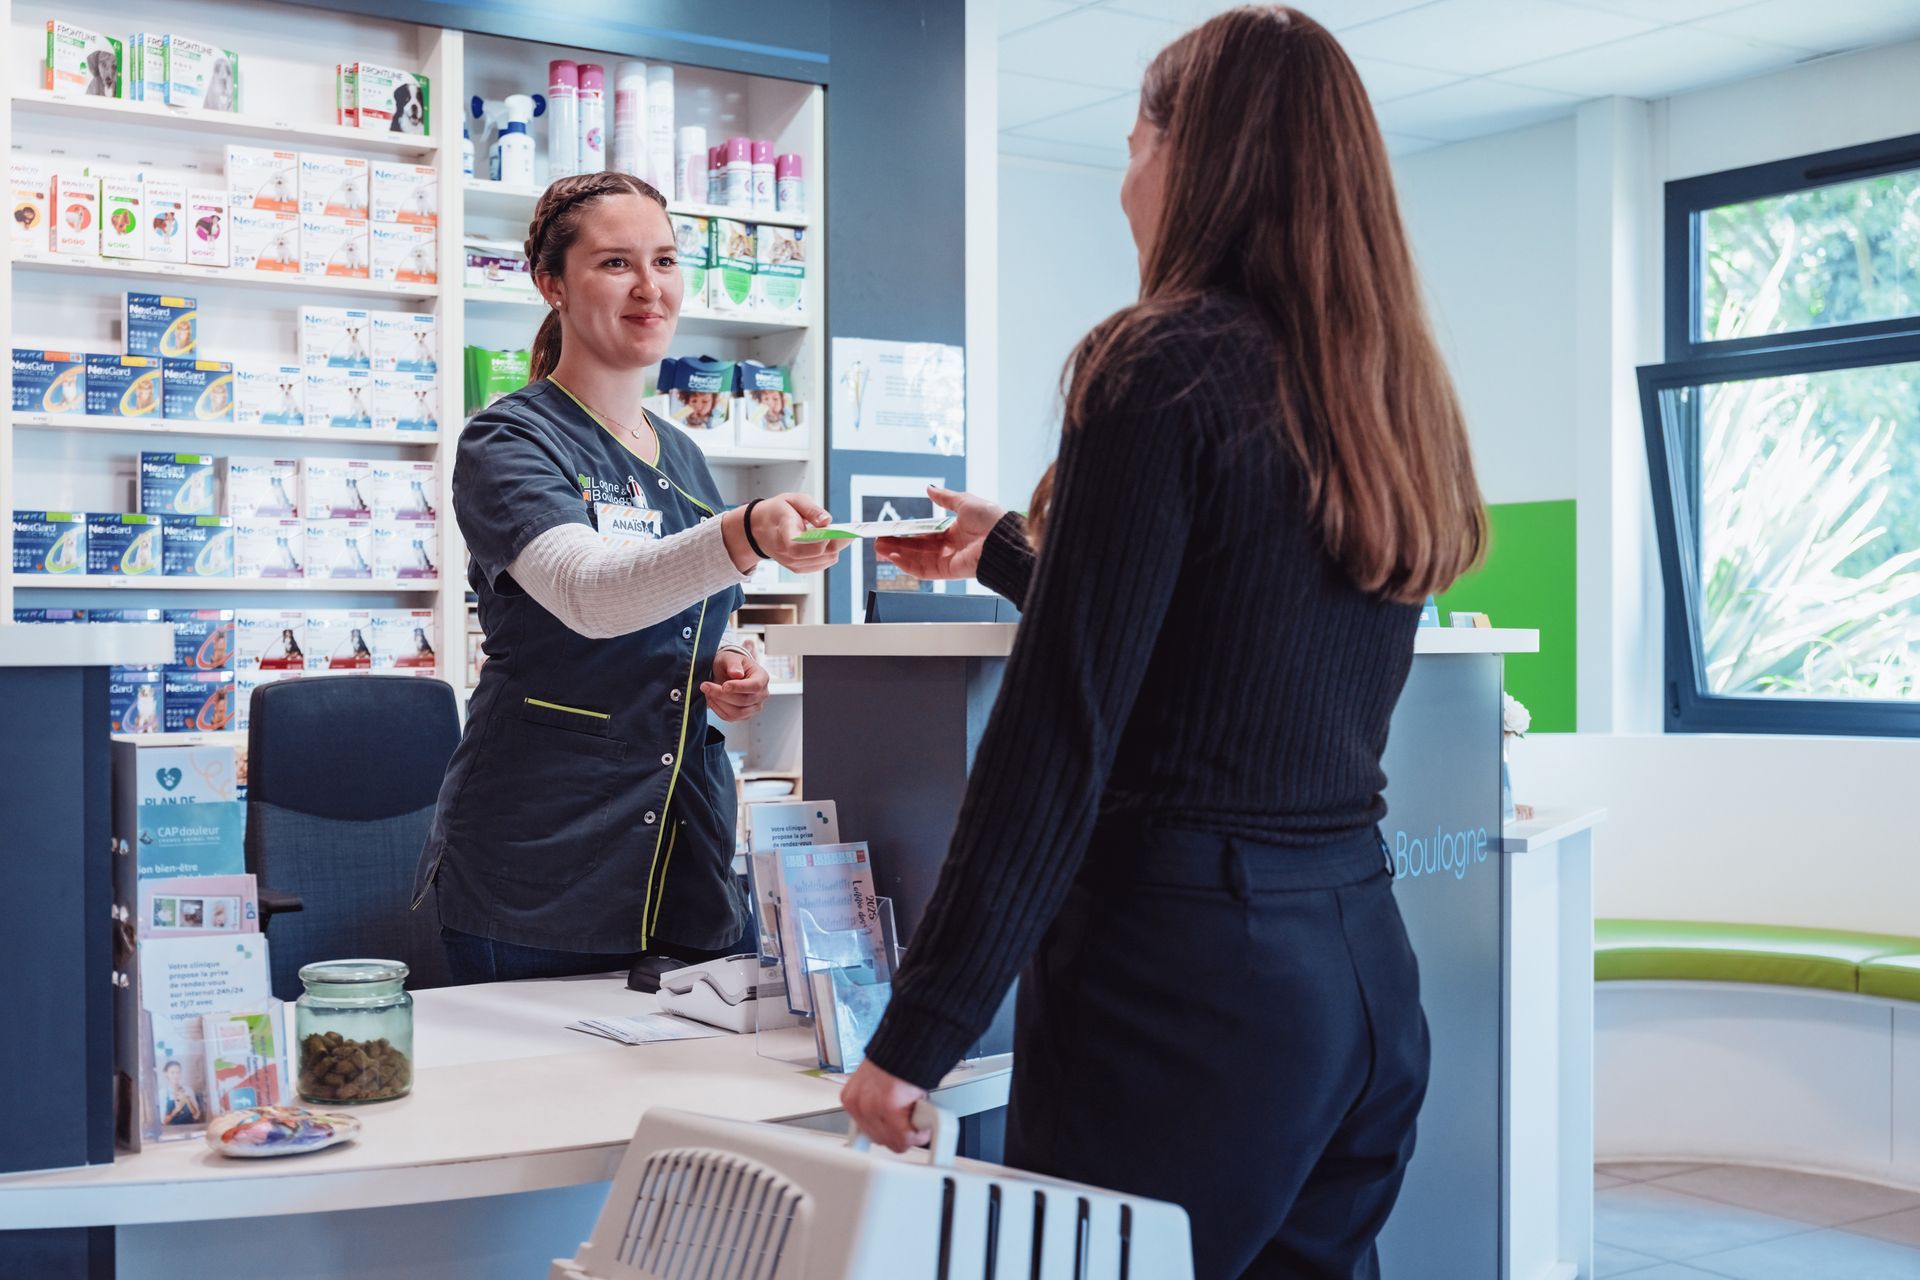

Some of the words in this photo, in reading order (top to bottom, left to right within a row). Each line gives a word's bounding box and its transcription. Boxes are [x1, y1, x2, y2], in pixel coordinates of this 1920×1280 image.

[129, 304, 170, 317] NexGard
[87, 365, 131, 376] NexGard
[164, 369, 206, 380] NexGard
[88, 524, 132, 535] NexGard
[163, 526, 206, 537] NexGard
[165, 683, 207, 694] NexGard
[786, 825, 807, 833] clinique
[1396, 825, 1488, 880] Boulogne
[155, 863, 199, 874] bien-être
[190, 961, 220, 969] clinique
